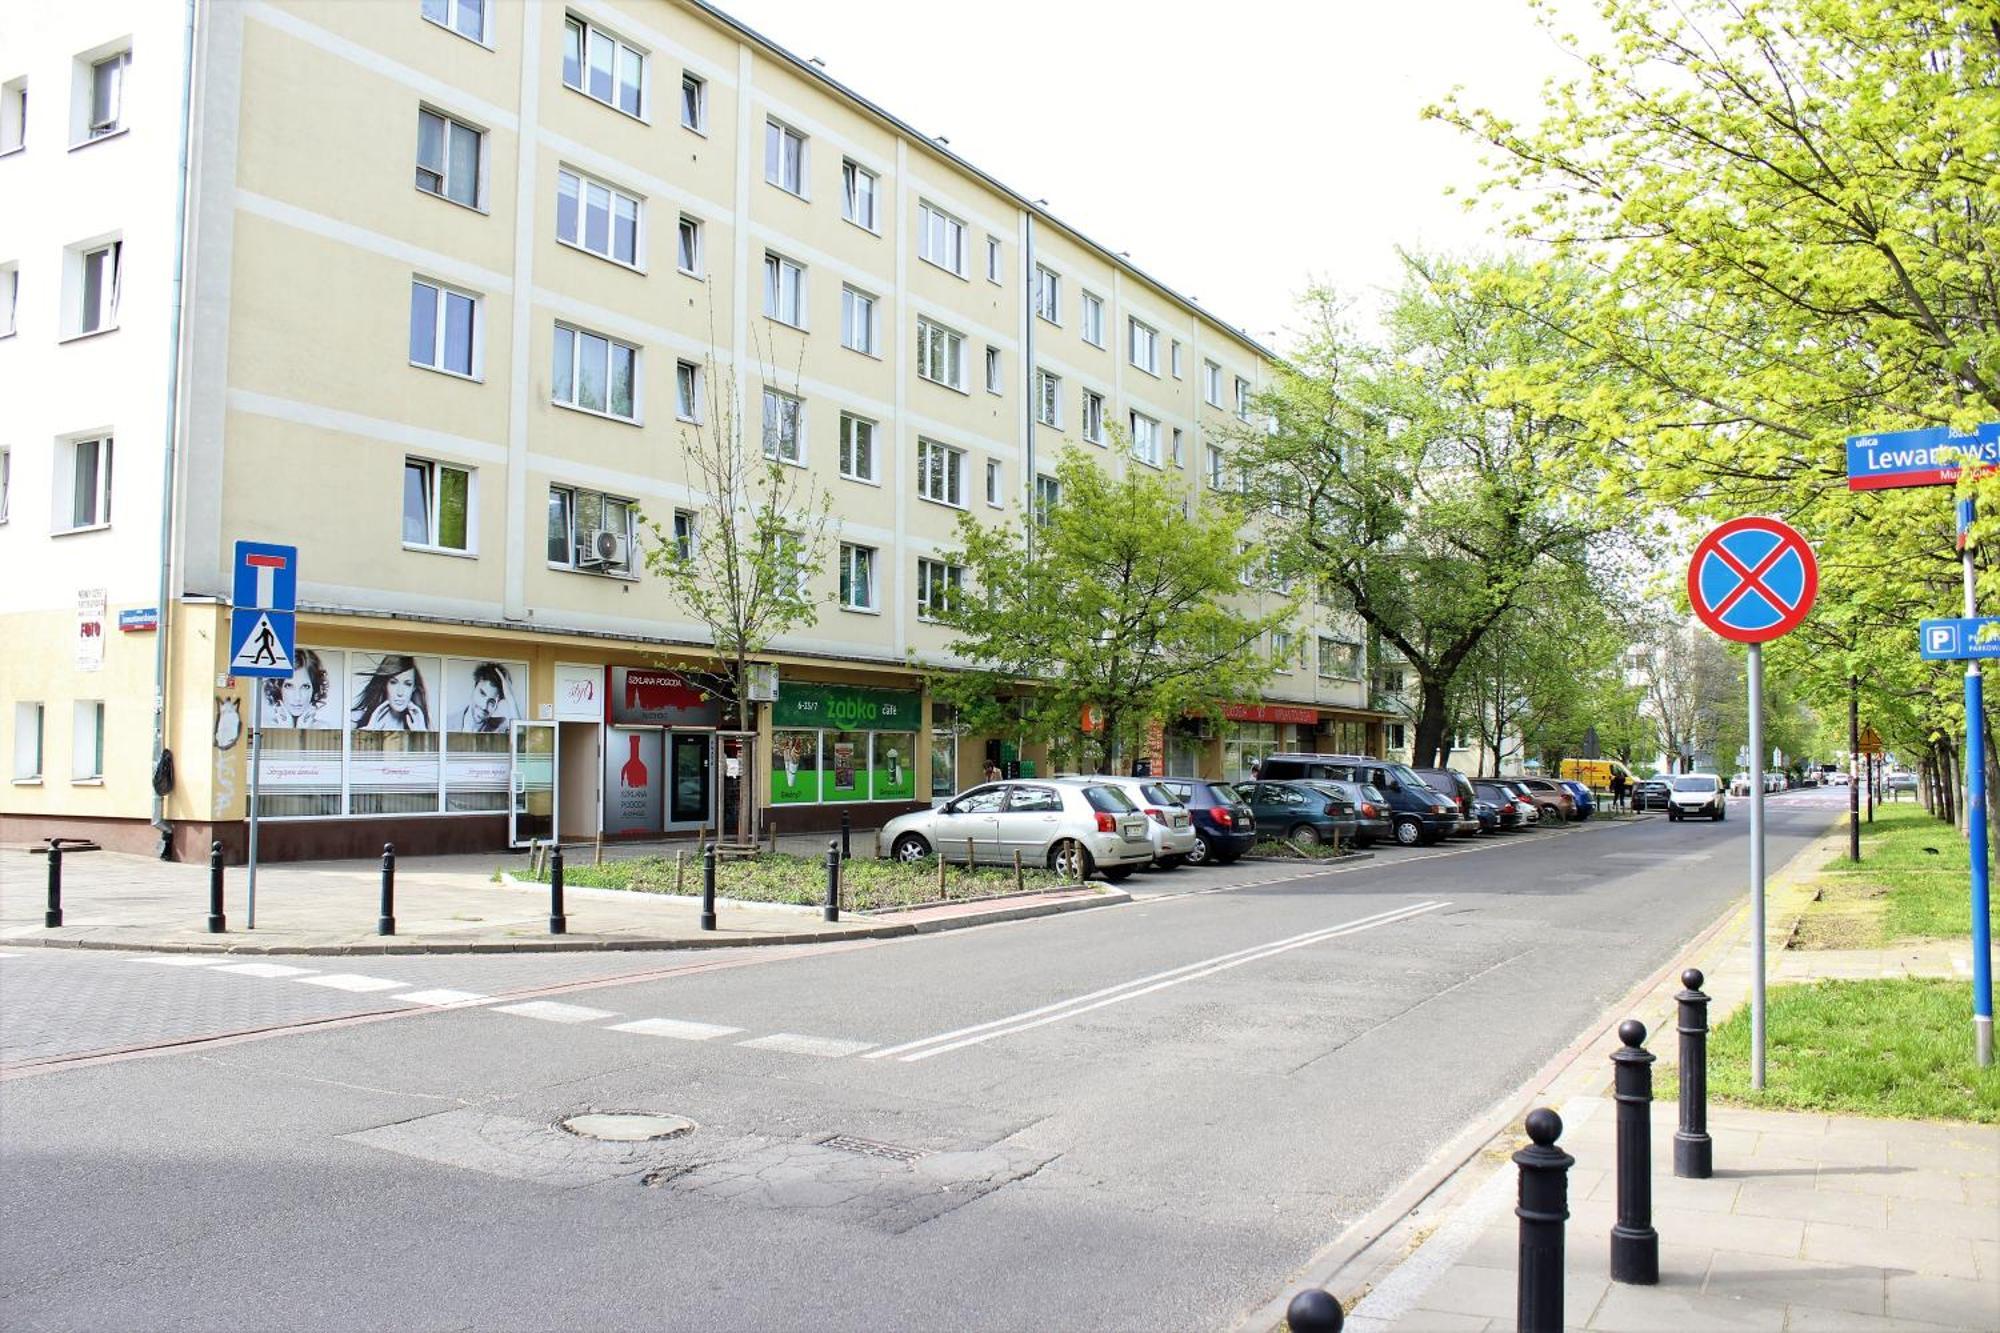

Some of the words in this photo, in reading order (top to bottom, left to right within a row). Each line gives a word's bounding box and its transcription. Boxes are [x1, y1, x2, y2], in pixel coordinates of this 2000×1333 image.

[1856, 438, 1878, 447] ulica
[81, 621, 101, 637] FOTO
[1933, 630, 1949, 649] P
[628, 675, 655, 686] SZKLANA
[656, 679, 682, 687] POGODA
[827, 695, 877, 719] żabka
